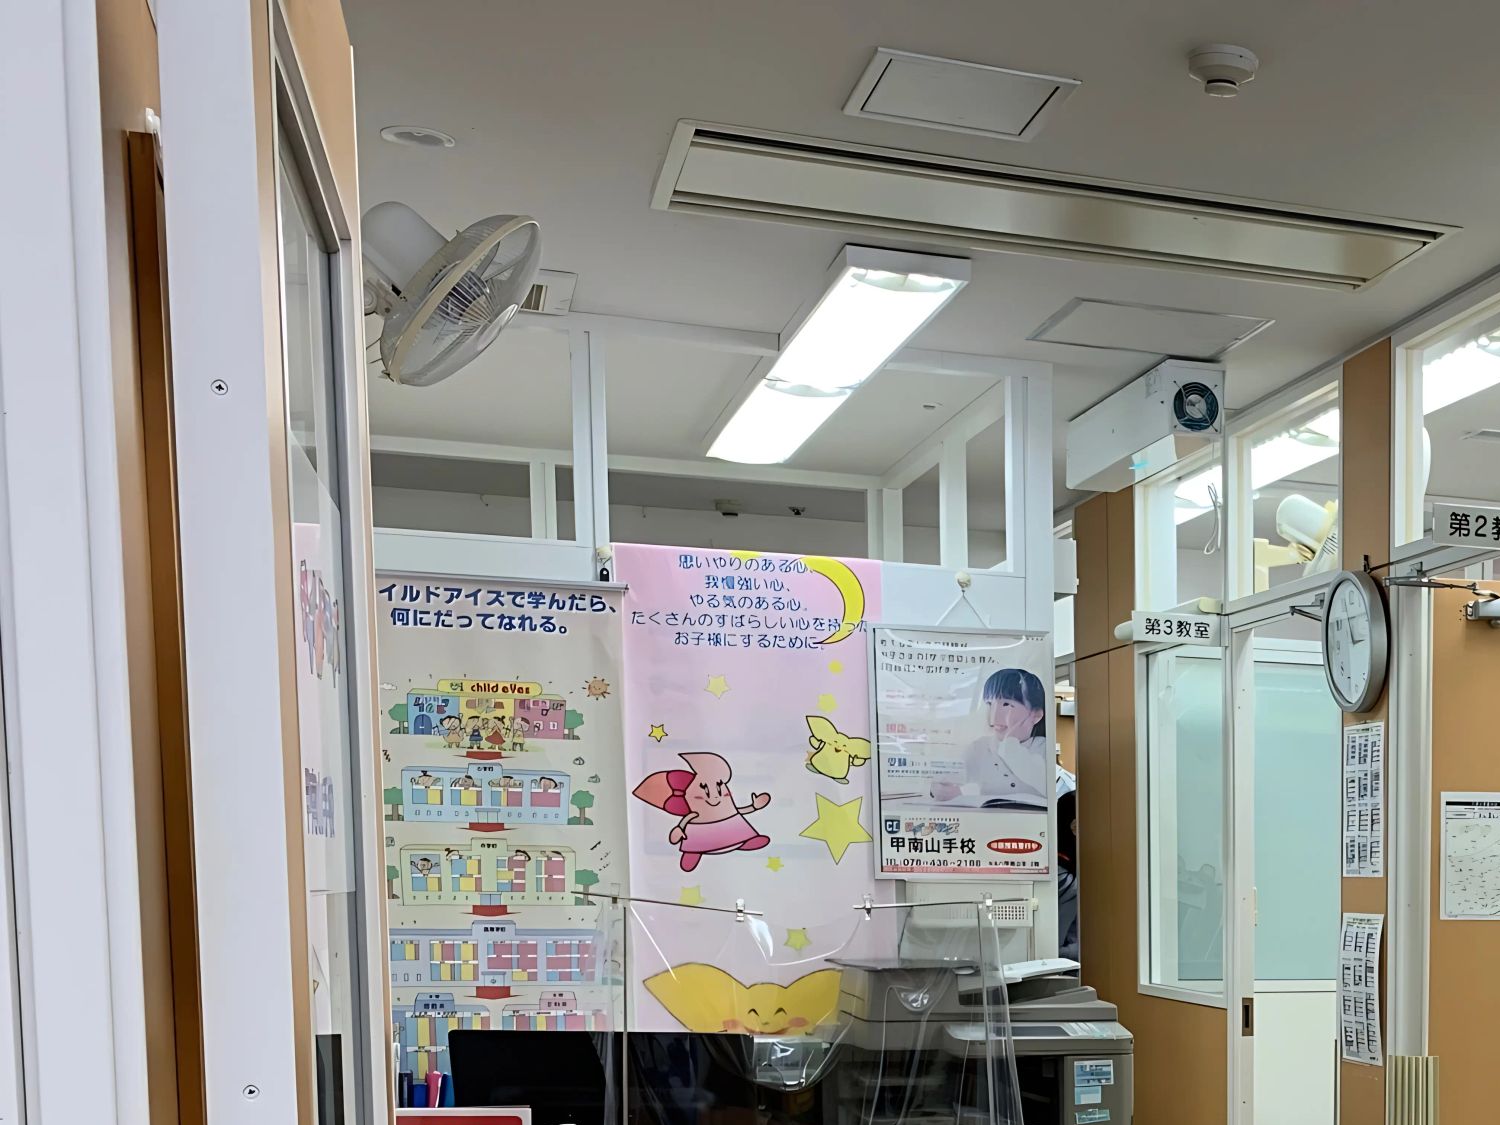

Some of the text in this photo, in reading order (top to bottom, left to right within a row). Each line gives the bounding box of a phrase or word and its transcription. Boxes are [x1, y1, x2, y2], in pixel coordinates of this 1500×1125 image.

[390, 607, 568, 635] 何にだってなれる。
[1145, 617, 1210, 639] 第3教室
[890, 836, 976, 855] 甲南山手校
